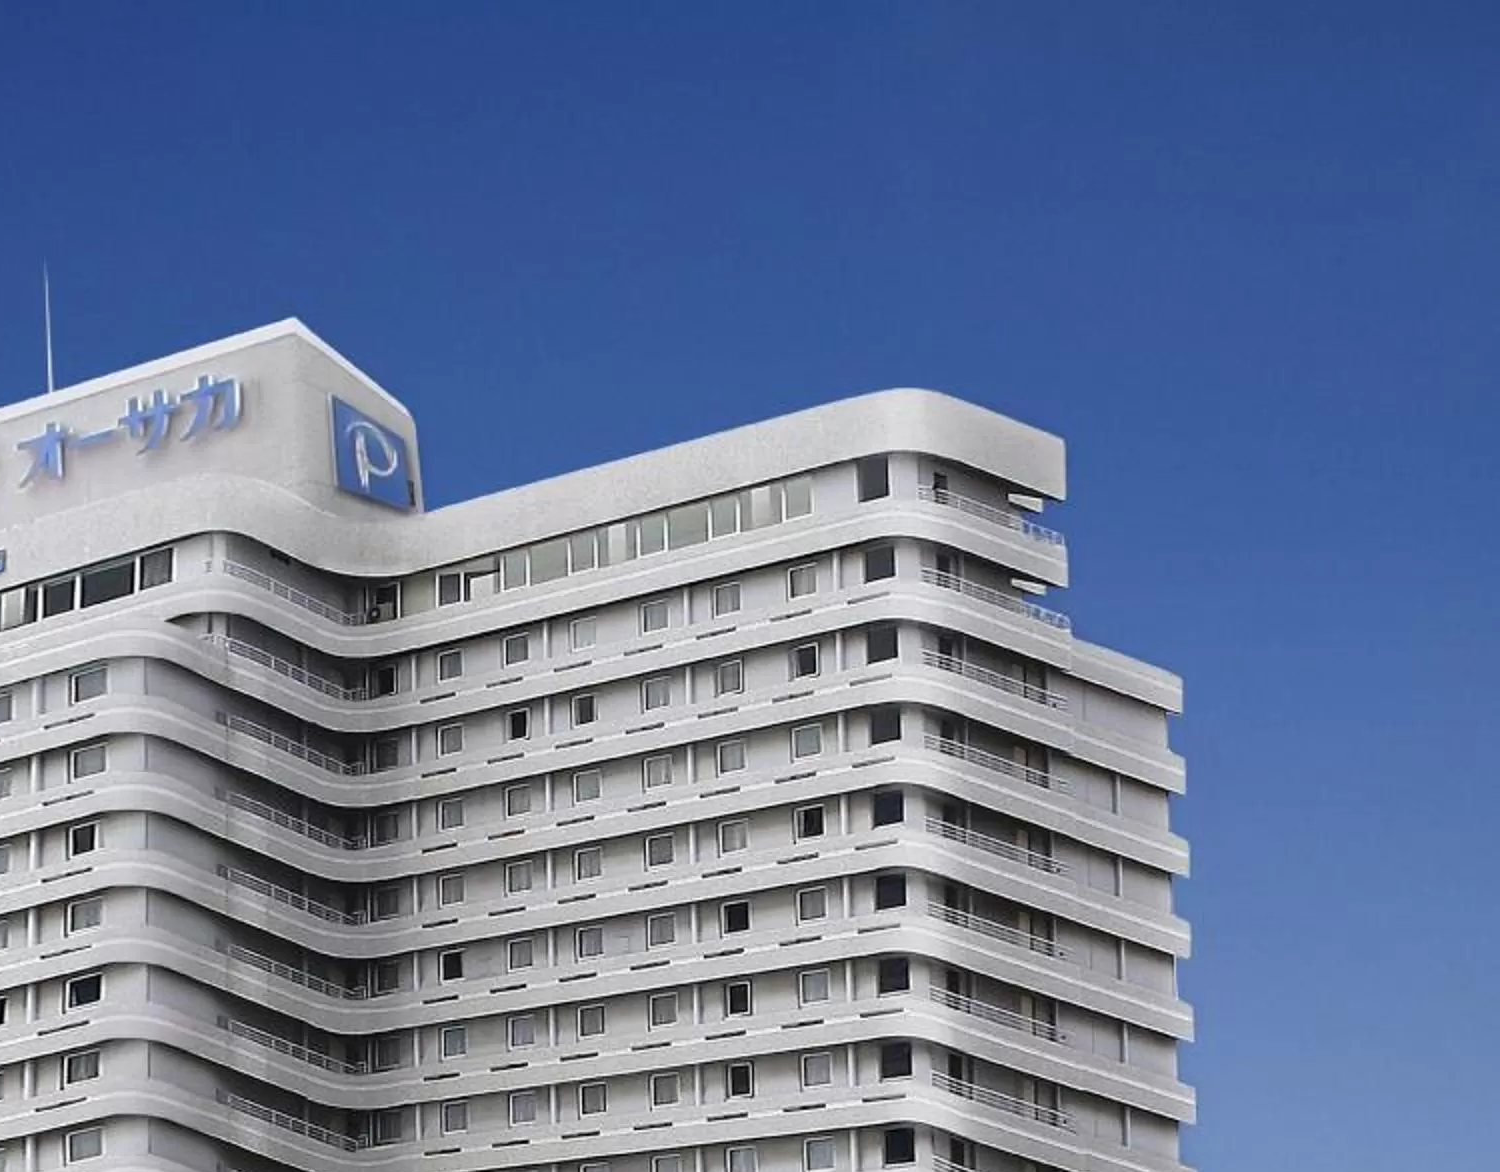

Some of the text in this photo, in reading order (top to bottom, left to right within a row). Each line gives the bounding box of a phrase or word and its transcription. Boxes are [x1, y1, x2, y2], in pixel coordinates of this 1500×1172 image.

[15, 374, 242, 489] オーサカ
[345, 421, 398, 494] P
